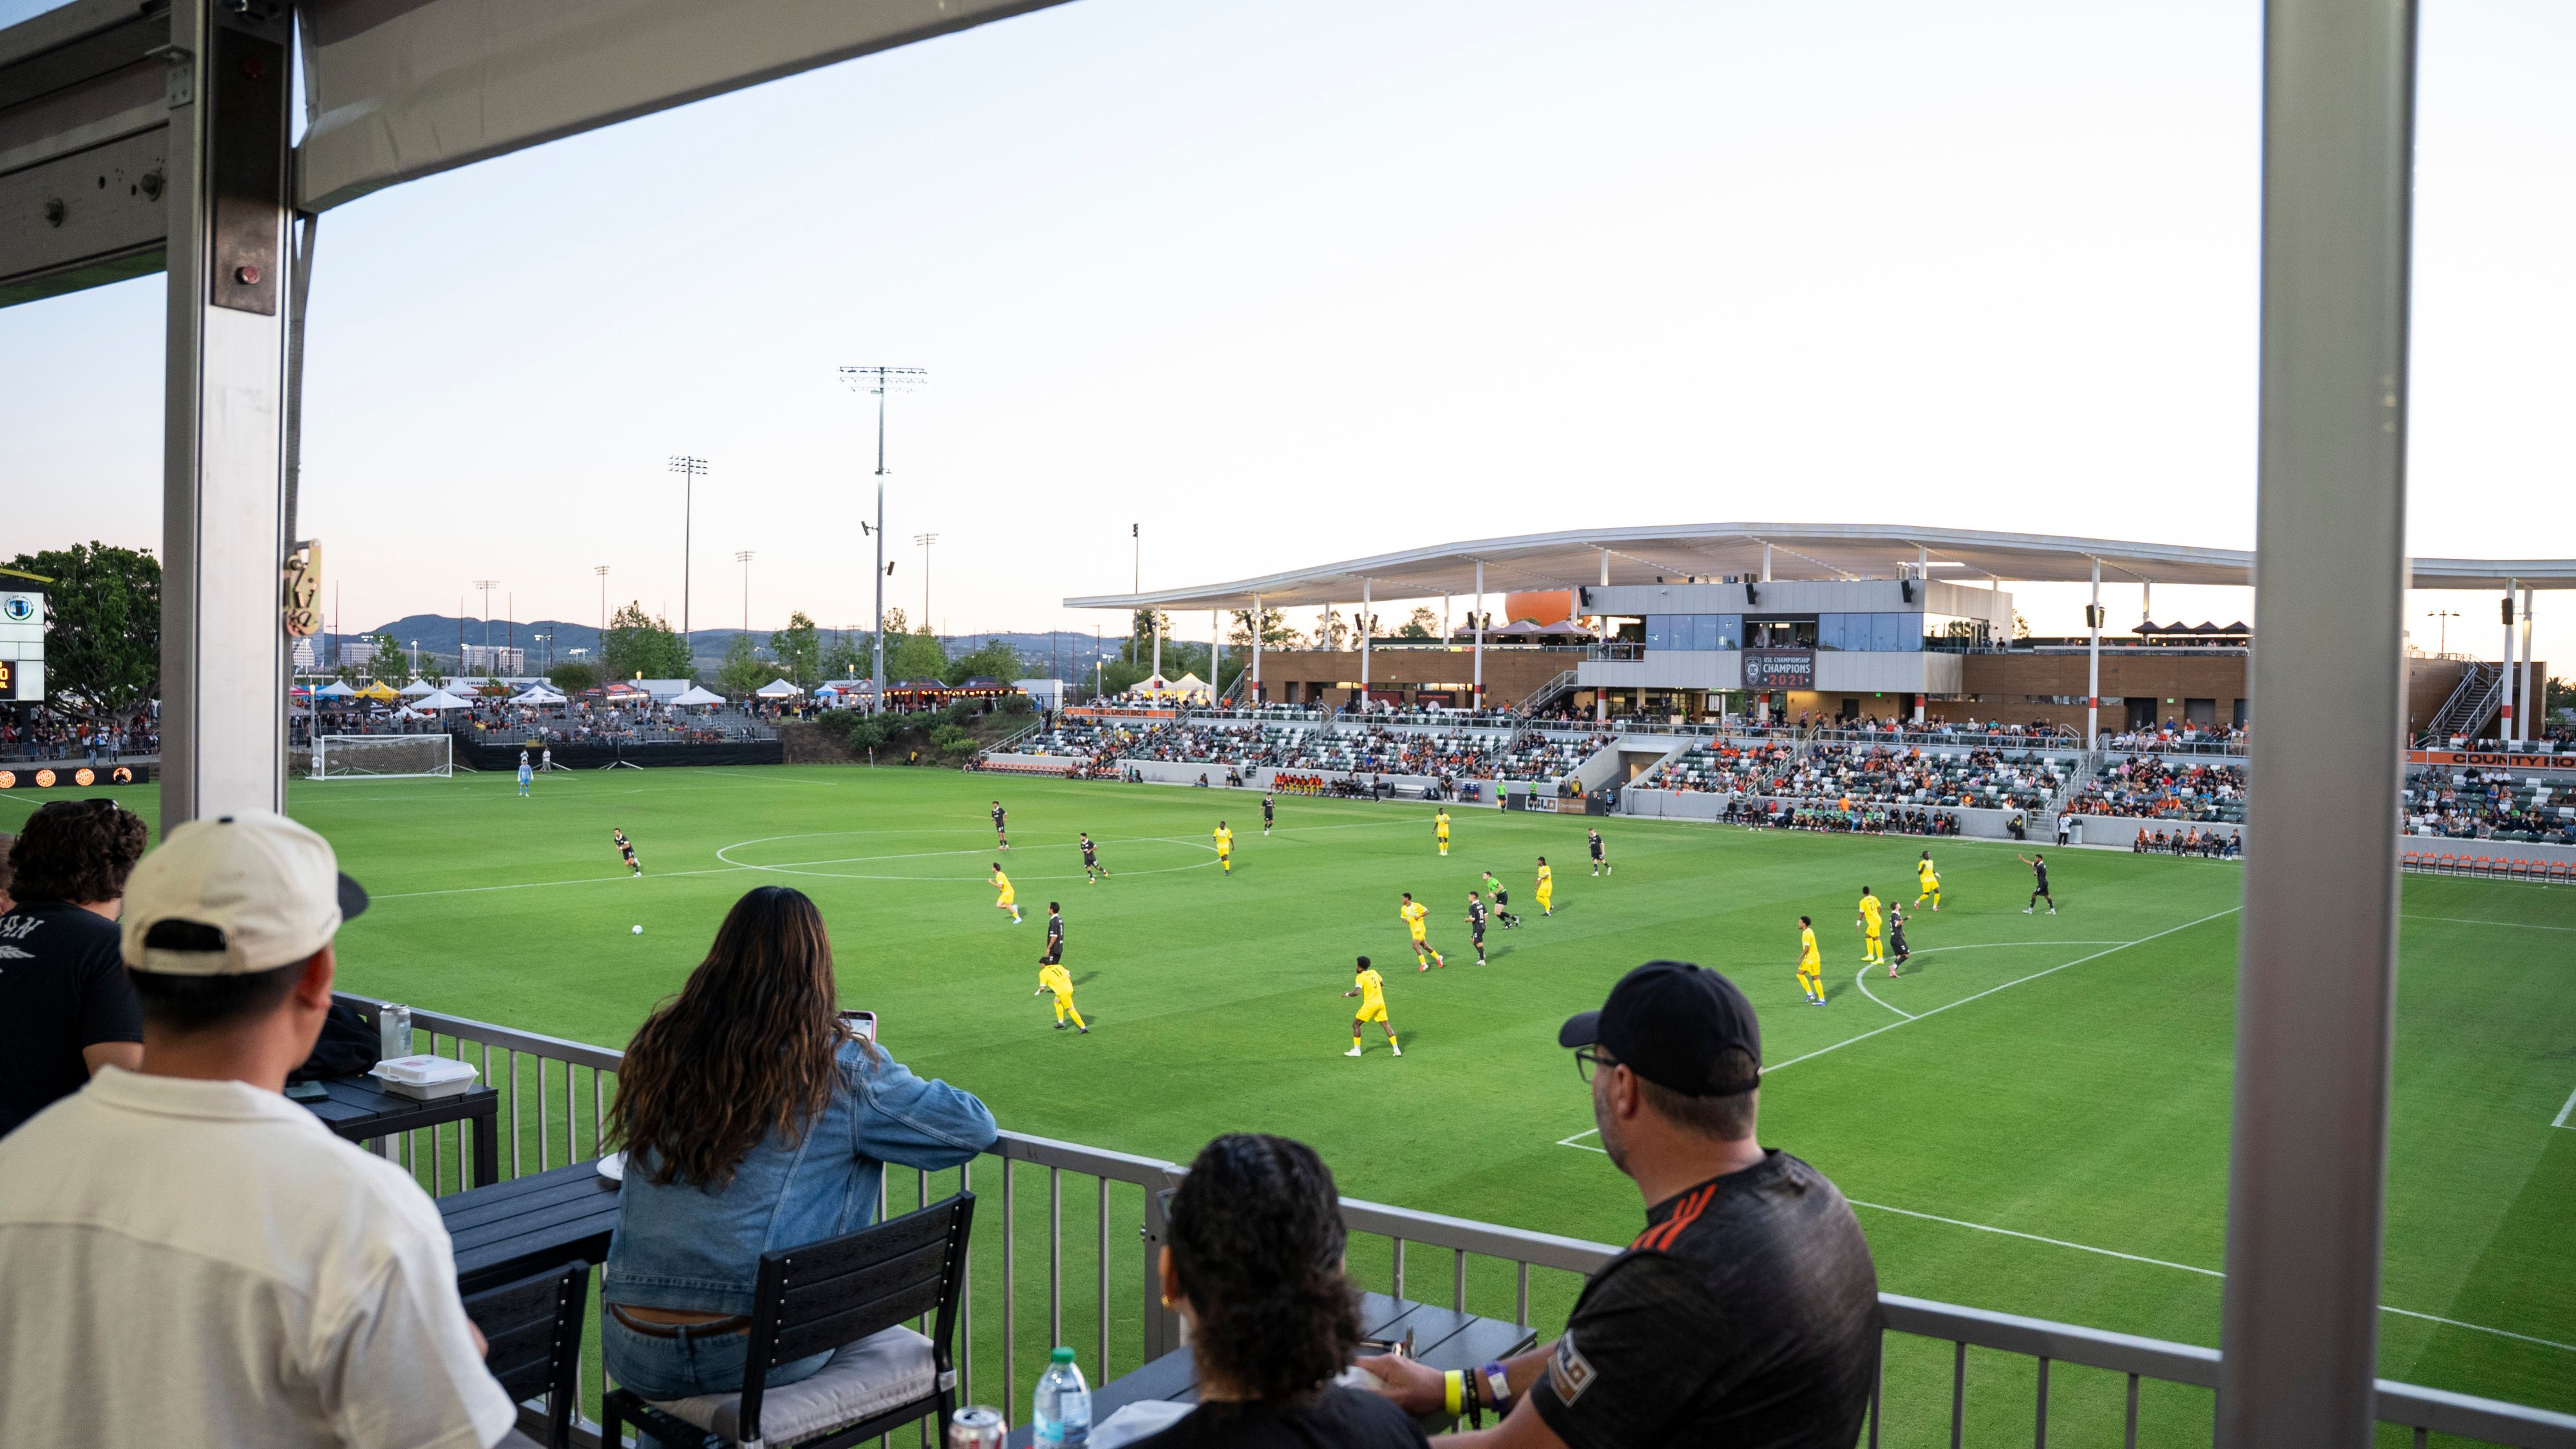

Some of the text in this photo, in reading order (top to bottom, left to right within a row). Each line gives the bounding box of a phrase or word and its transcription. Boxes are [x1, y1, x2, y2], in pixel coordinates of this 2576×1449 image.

[1763, 663, 1811, 674] CHAMPIONS
[1769, 674, 1804, 685] 2021
[2452, 754, 2576, 767] COUNTY RO
[1371, 977, 1377, 989] 3
